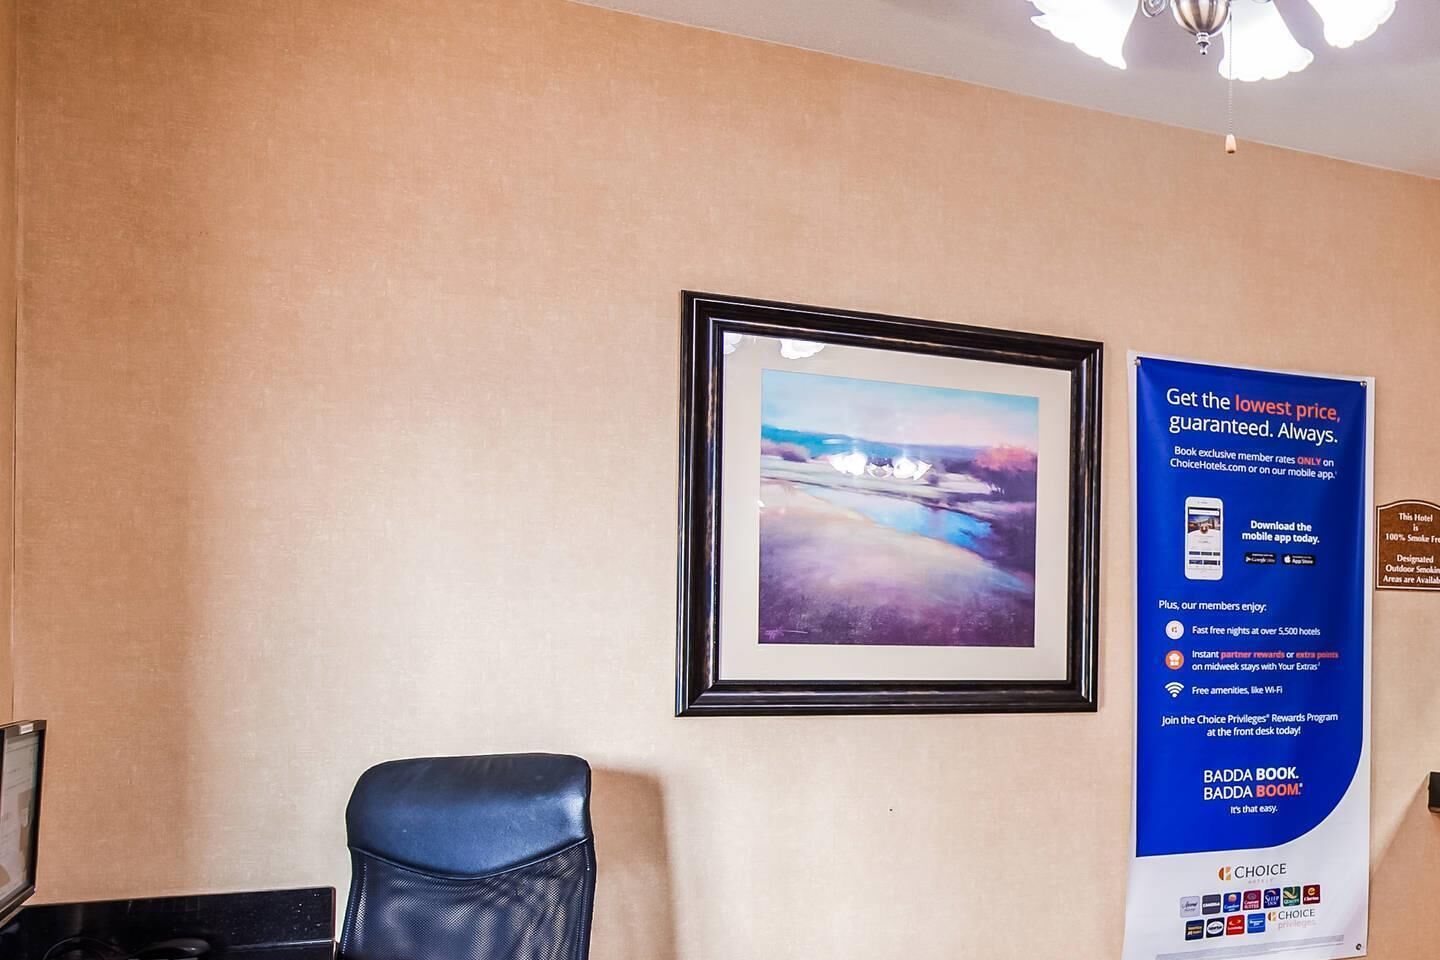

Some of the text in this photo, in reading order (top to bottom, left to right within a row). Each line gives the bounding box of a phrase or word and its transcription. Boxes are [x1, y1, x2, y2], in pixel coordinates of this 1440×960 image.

[1167, 388, 1341, 422] Get the lowest price,
[1169, 415, 1338, 446] guaranteed. Always.
[1174, 446, 1334, 467] Book exclusive member rates ONLY on
[1170, 459, 1246, 473] ChoiceHotels.com
[1248, 465, 1258, 473] or
[1259, 466, 1270, 474] on
[1272, 467, 1286, 475] our
[1288, 467, 1316, 478] mobile
[1399, 512, 1433, 522] This Hotel
[1250, 520, 1312, 532] Download the
[1413, 524, 1418, 532] is
[1242, 532, 1320, 545] mobile app today.
[1385, 533, 1406, 542] 100%
[1407, 534, 1429, 543] Smoke
[1397, 554, 1434, 564] Designated
[1385, 564, 1414, 573] Outdoor
[1383, 575, 1402, 583] Areas
[1159, 600, 1266, 613] Plus, our members enjoy:
[1192, 626, 1208, 635] Fast
[1210, 626, 1225, 635] free
[1227, 626, 1250, 637] nights
[1251, 627, 1259, 635] at
[1260, 627, 1277, 636] over
[1299, 627, 1320, 636] hotels
[1192, 650, 1219, 659] Instant
[1220, 651, 1252, 661] partner
[1253, 650, 1285, 659] rewards
[1317, 651, 1339, 660] points
[1192, 663, 1203, 671] on
[1204, 662, 1239, 671] midweek
[1240, 662, 1260, 672] stays
[1261, 662, 1277, 671] with
[1278, 662, 1295, 671] Your
[1192, 686, 1283, 695] Free amenities, like Wi-Fi
[1161, 715, 1179, 726] Join
[1181, 715, 1195, 724] the
[1197, 714, 1226, 724] Choice
[1271, 713, 1305, 723] Rewards
[1306, 712, 1338, 724] Program
[1207, 726, 1301, 737] at the front desk today!
[1204, 766, 1299, 783] BADDA BOOK.
[1204, 785, 1253, 800] BADDA
[1230, 804, 1278, 815] It's that easy.
[1235, 863, 1287, 879] CHOICE
[1278, 909, 1315, 920] CHOICE
